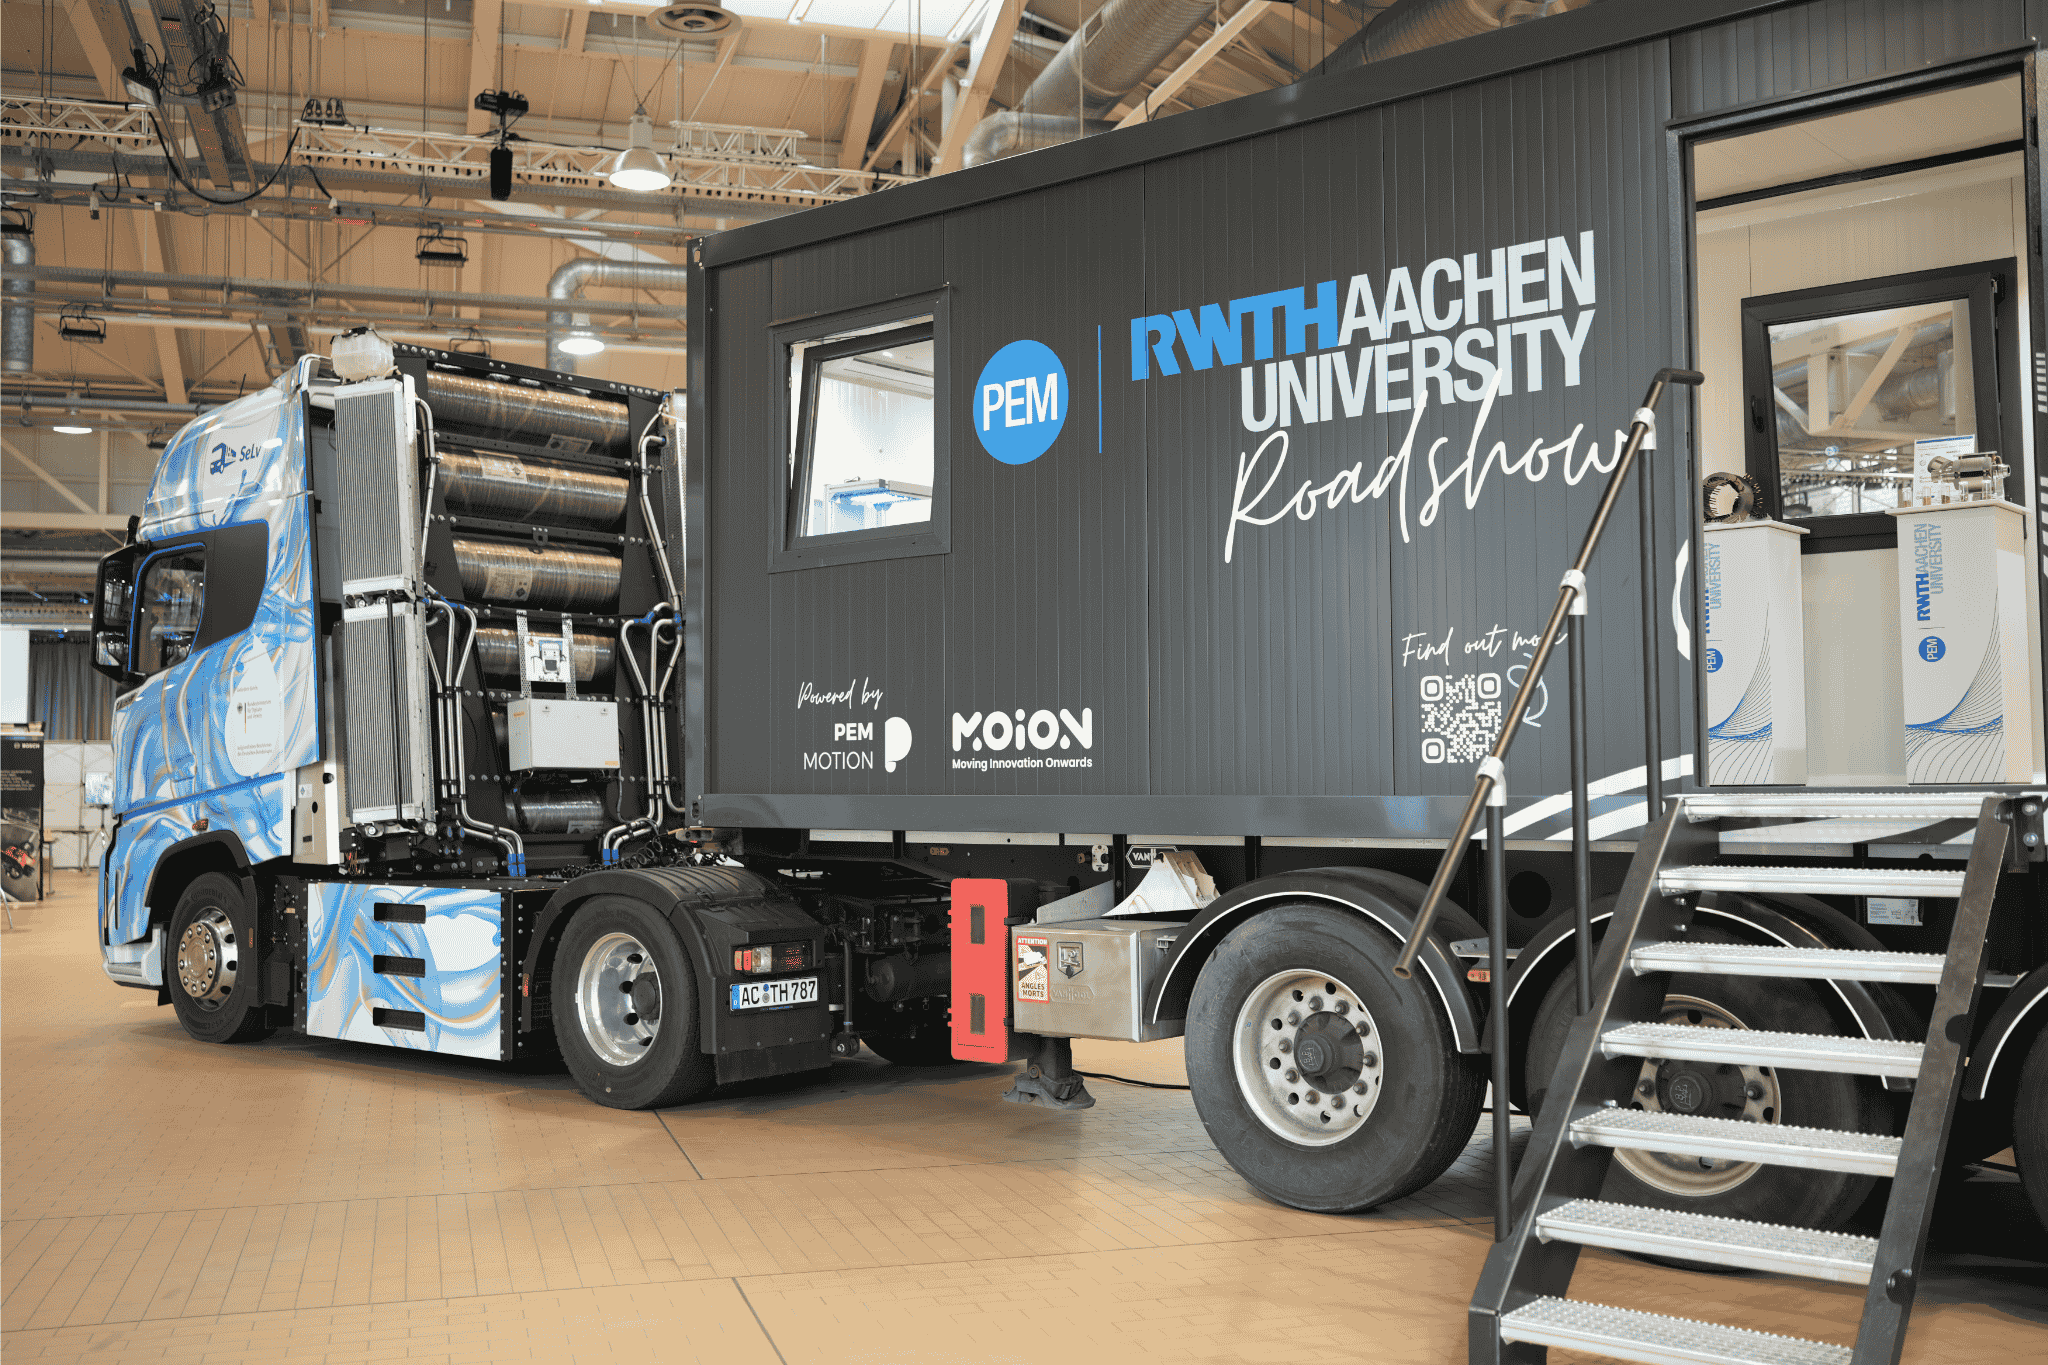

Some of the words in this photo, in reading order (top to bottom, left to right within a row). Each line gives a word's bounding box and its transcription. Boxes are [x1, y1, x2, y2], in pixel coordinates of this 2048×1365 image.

[1241, 309, 1596, 432] UNIVERSITY
[983, 372, 1058, 431] PEM
[1224, 368, 1630, 563] Roadshow
[1928, 523, 1944, 594] UNIVERSITY
[1402, 627, 1454, 667] Find
[1464, 624, 1508, 657] out
[1926, 638, 1939, 661] PEM
[798, 679, 856, 709] Powered
[861, 677, 883, 710] by
[834, 722, 873, 741] PEM
[803, 751, 874, 770] MOTION
[952, 758, 988, 772] Moving
[989, 757, 1043, 769] Innovation
[1045, 757, 1093, 768] Onwards
[1018, 937, 1047, 946] ATTENTION
[741, 986, 760, 1005] AC
[770, 982, 788, 1002] TH
[791, 980, 816, 1000] 787
[1021, 982, 1045, 990] ANGLES
[1022, 990, 1045, 998] MORTS
